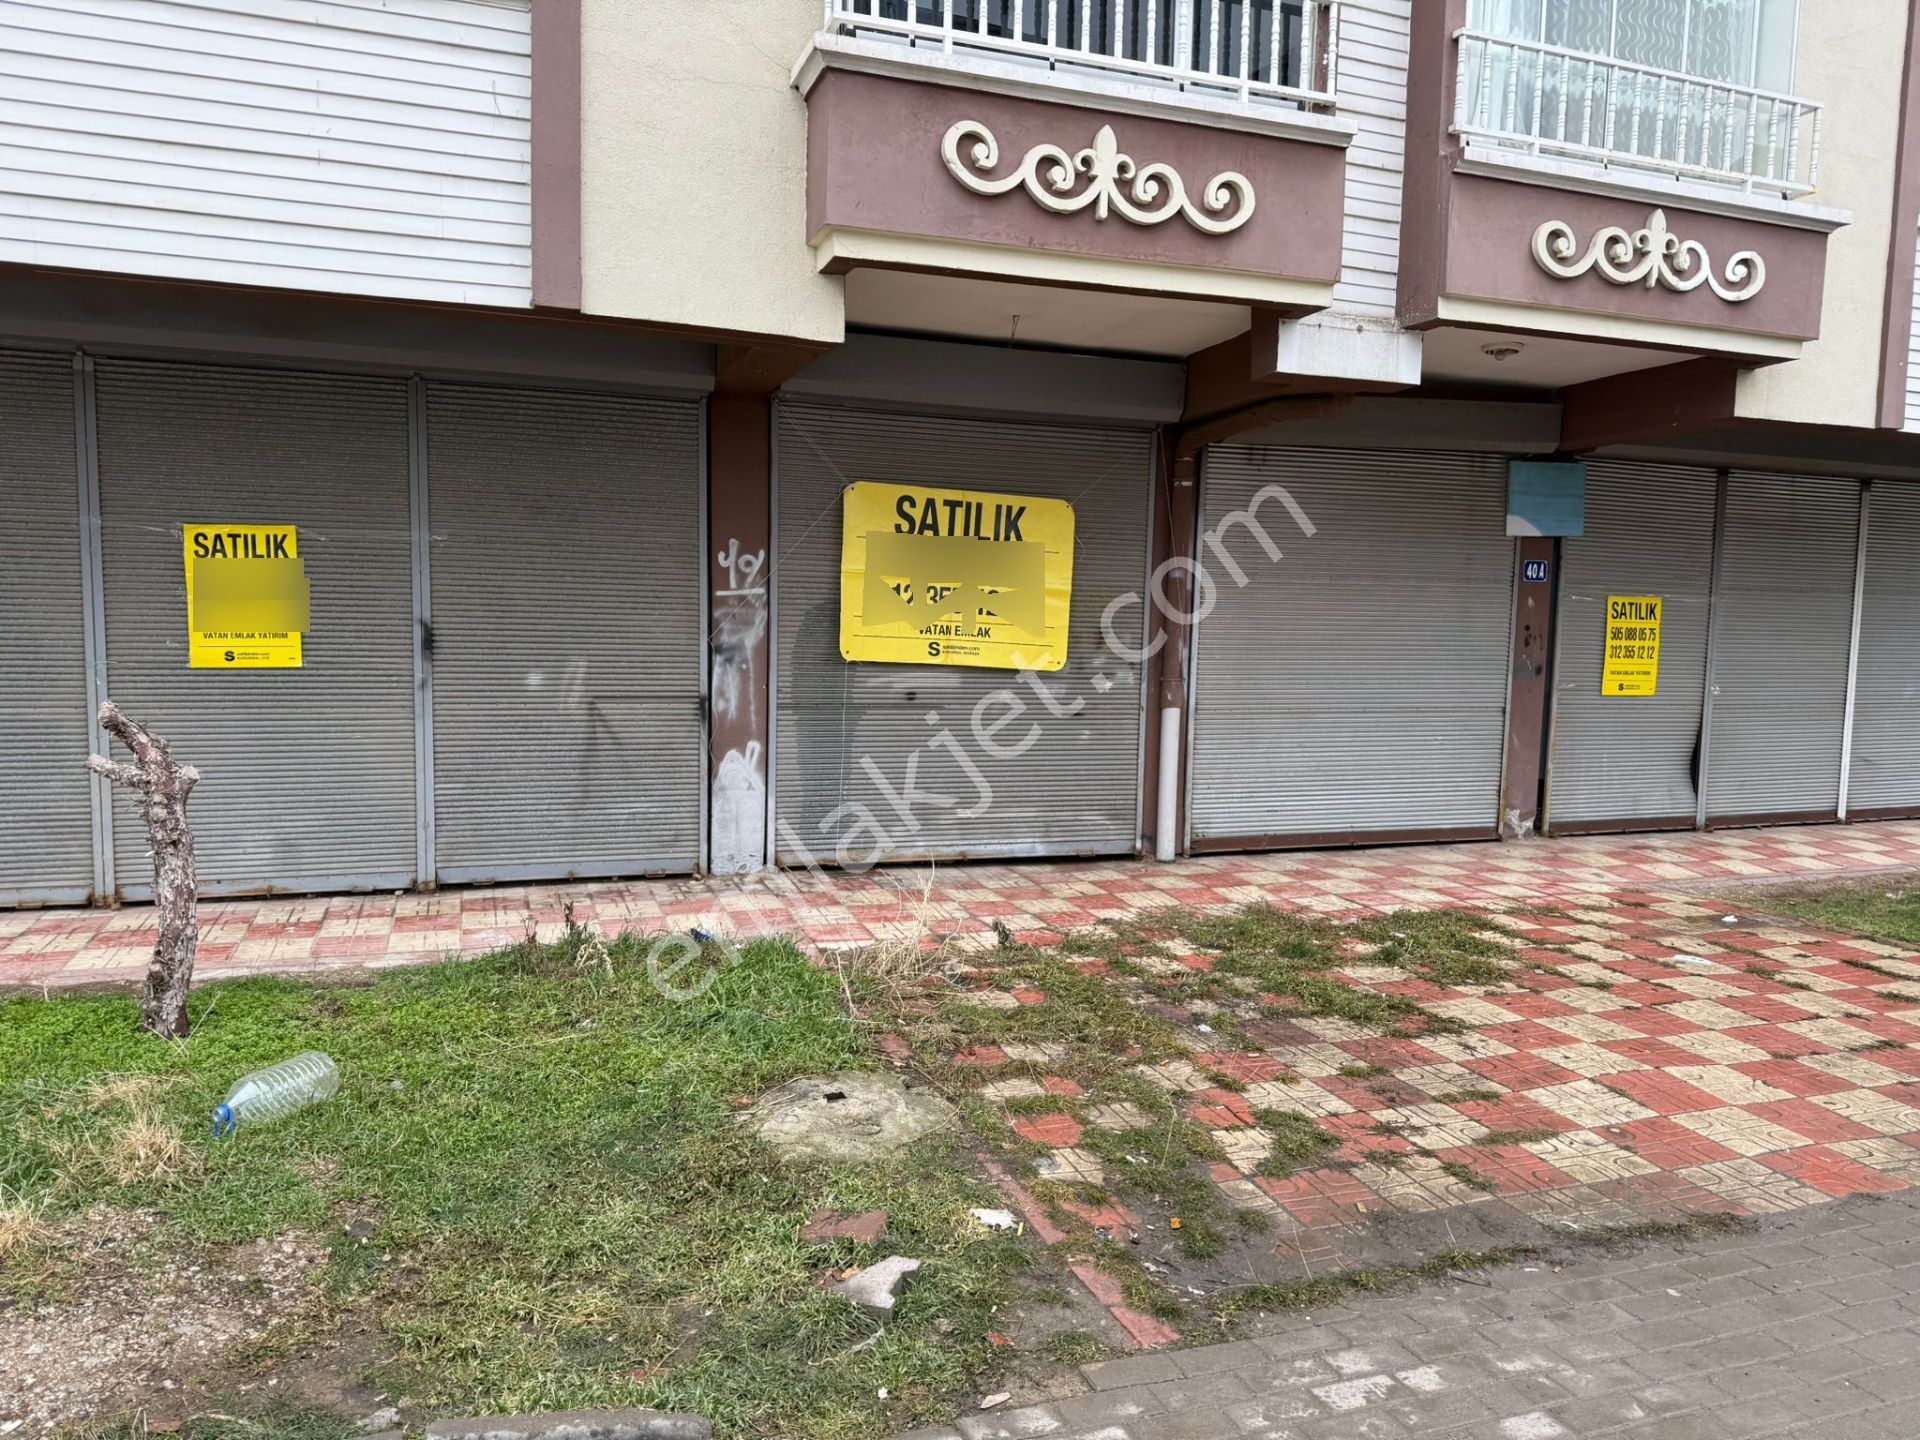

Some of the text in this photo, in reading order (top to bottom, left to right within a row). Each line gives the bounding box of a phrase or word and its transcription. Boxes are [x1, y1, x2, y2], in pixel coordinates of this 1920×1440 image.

[894, 494, 1027, 542] SATILIK
[193, 532, 289, 558] SATILIK
[1611, 601, 1658, 621] SATILIK
